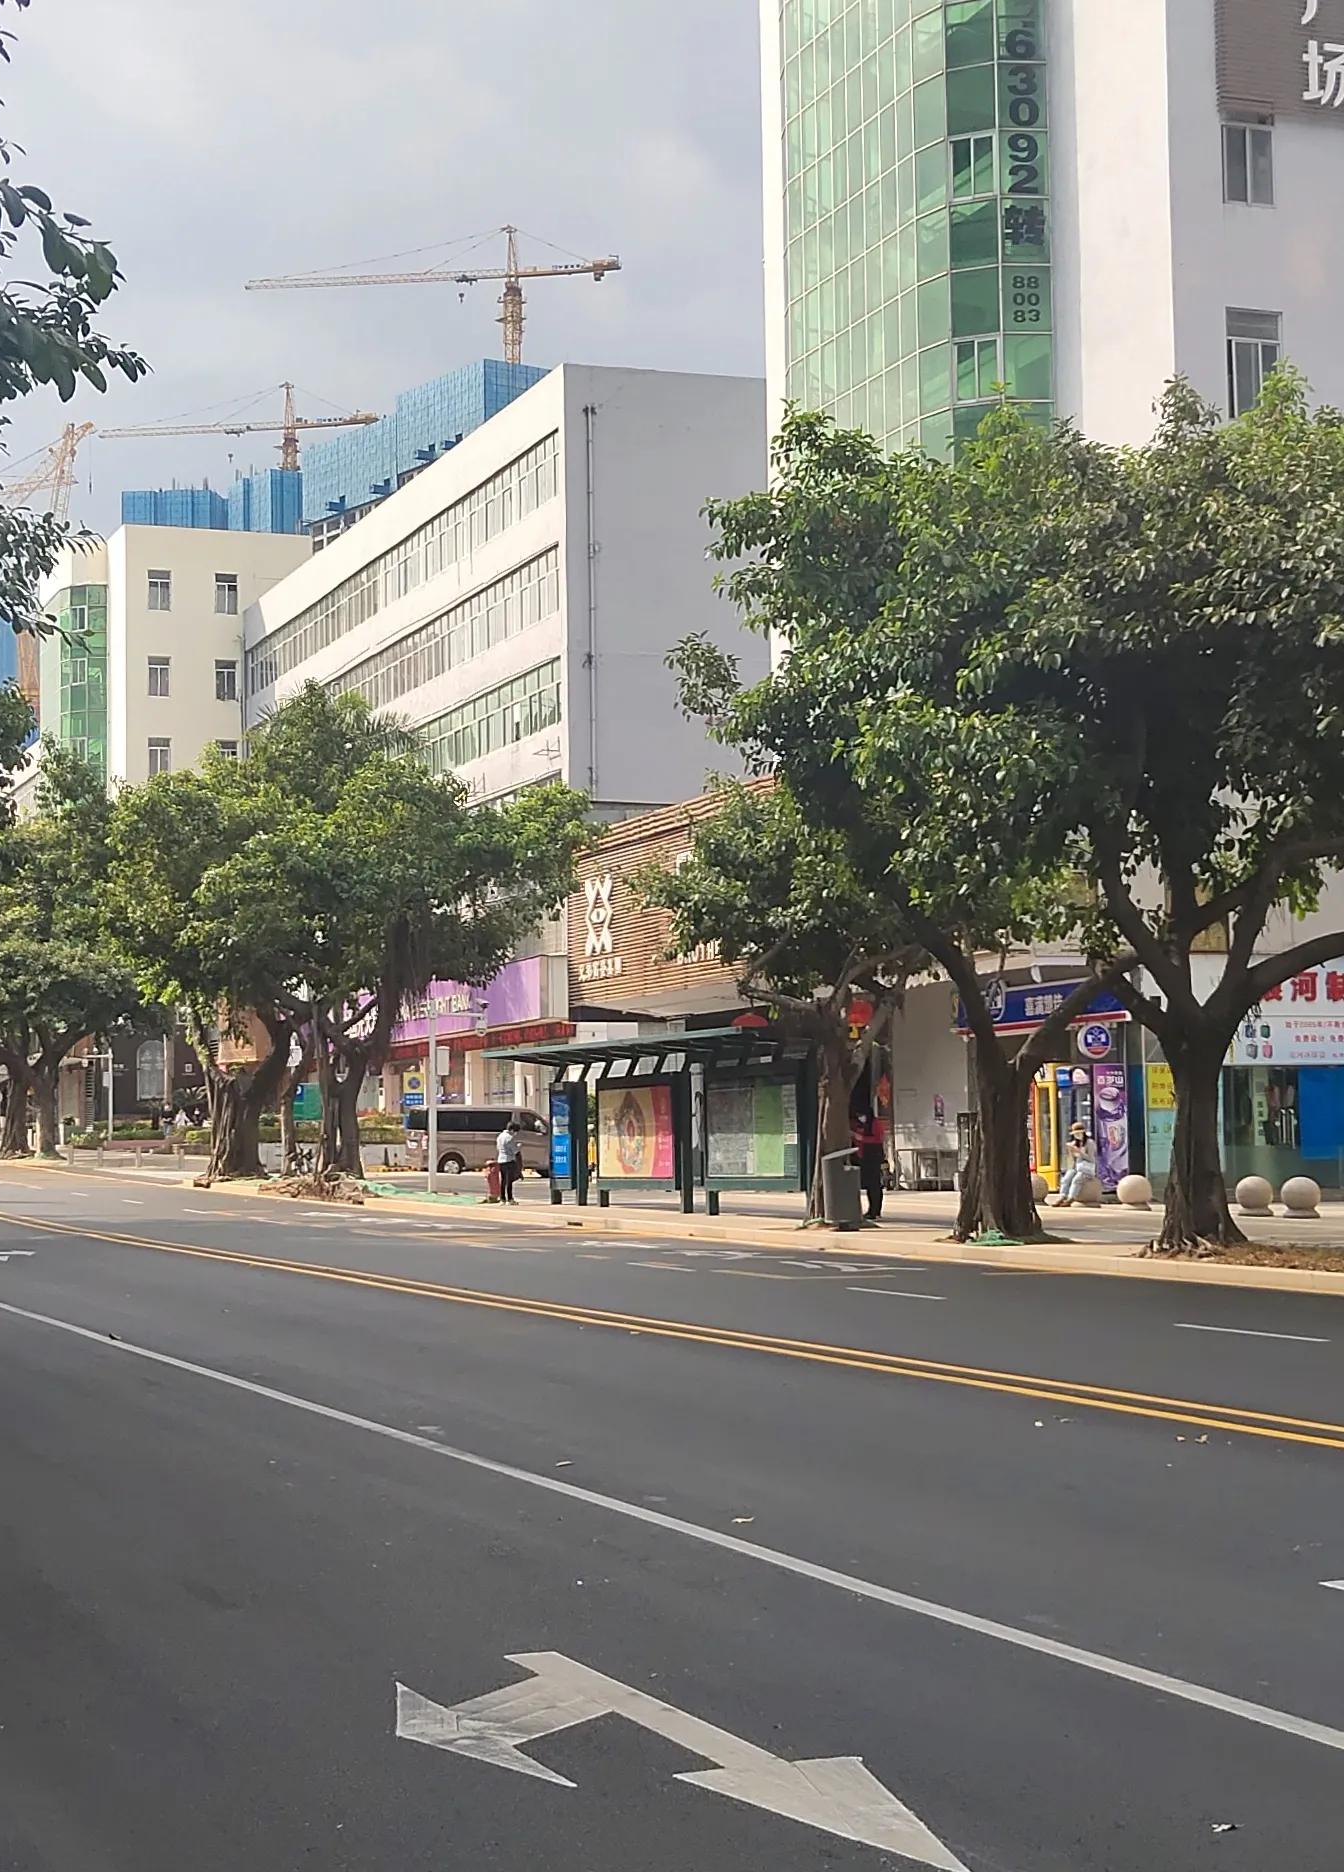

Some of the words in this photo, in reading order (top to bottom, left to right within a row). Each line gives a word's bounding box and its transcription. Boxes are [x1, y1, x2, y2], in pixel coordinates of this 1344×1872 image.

[1012, 276, 1039, 289] 88
[1012, 292, 1040, 306] 00
[1012, 309, 1040, 323] 83
